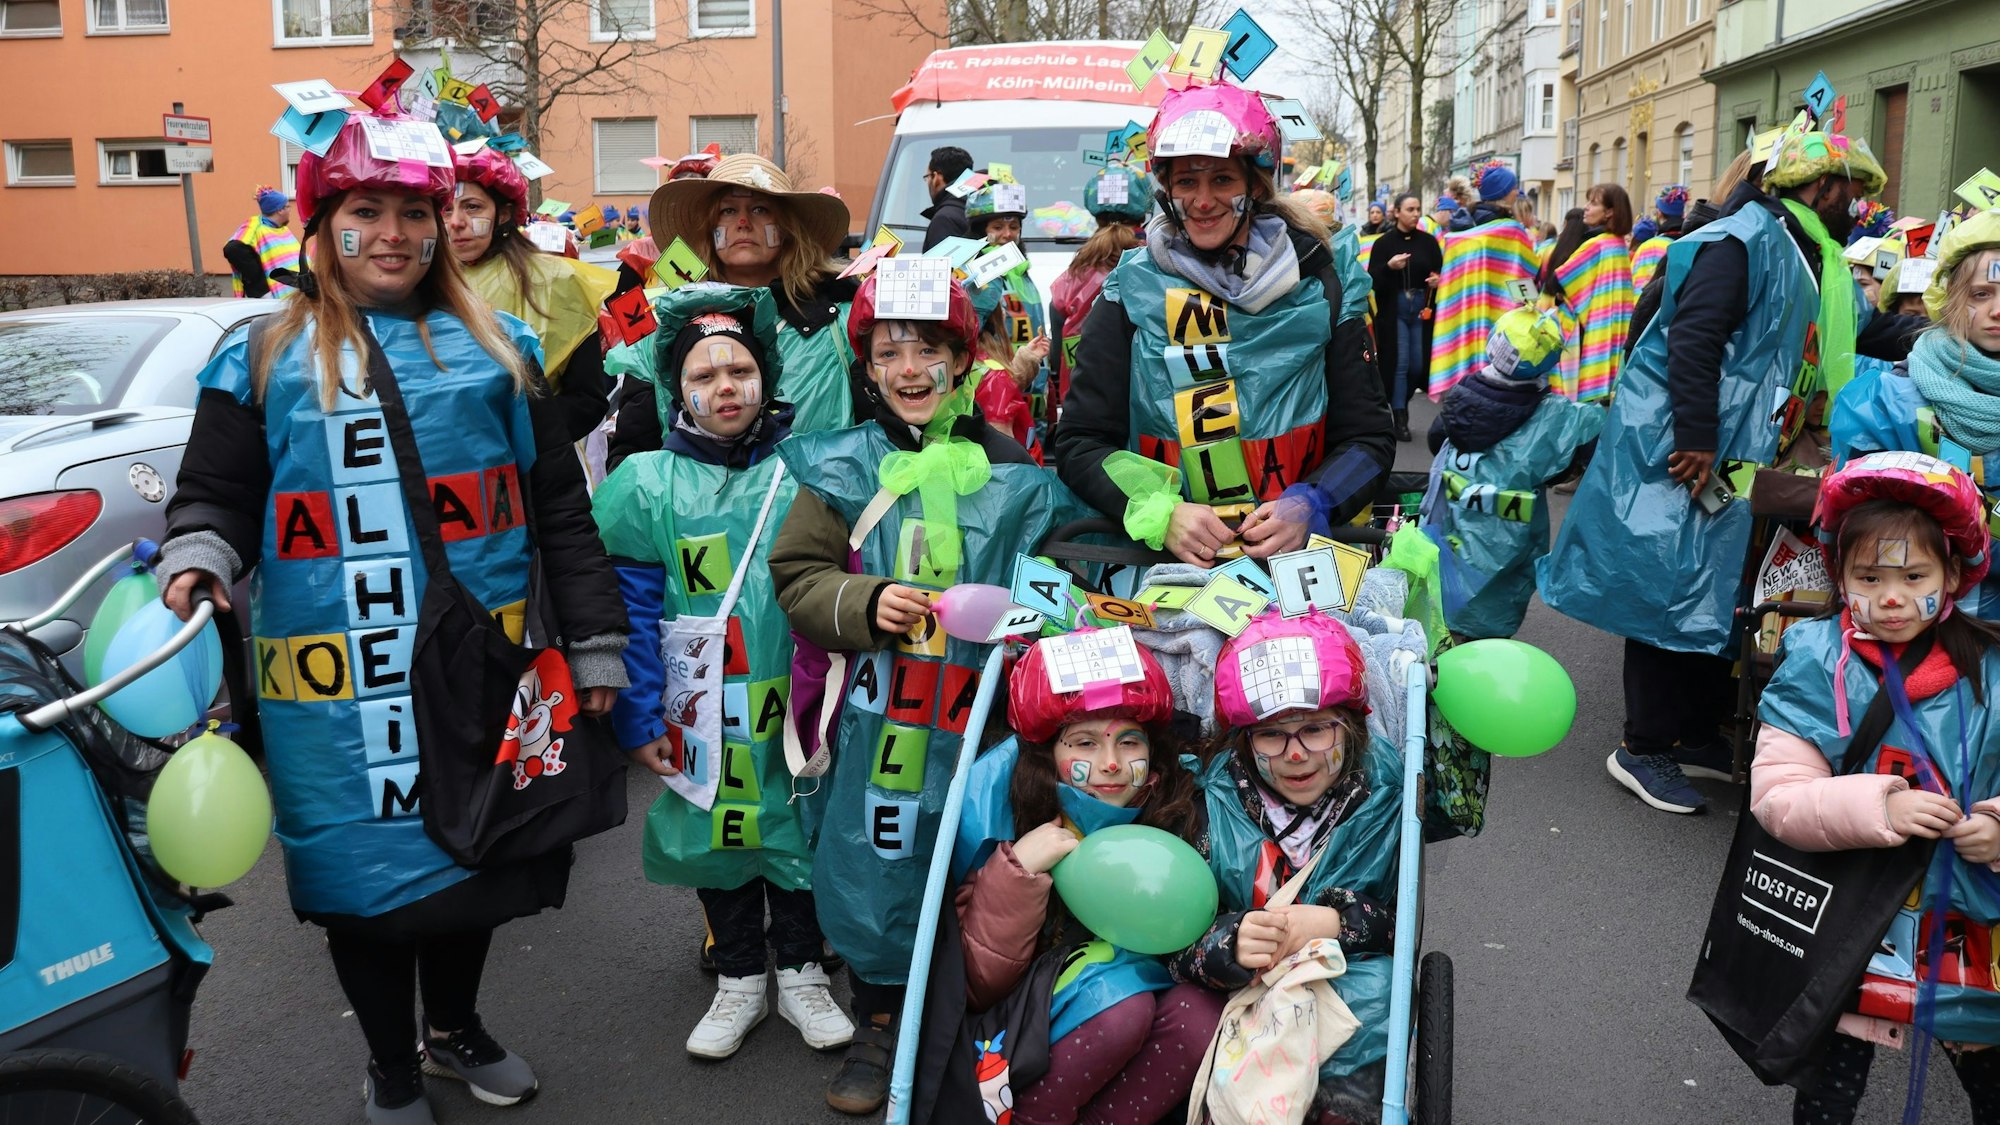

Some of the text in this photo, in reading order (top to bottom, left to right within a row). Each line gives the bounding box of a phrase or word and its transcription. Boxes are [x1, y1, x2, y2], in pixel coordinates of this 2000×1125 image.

[1189, 41, 1204, 67] L
[1228, 33, 1250, 62] L
[965, 55, 1078, 69] Realschule
[1084, 55, 1129, 69] Lass
[1143, 56, 1159, 71] L
[986, 75, 1133, 93] Köln-Mülheim
[167, 118, 208, 131] Feuerwehrzufahrt
[1281, 115, 1306, 126] F
[343, 233, 354, 252] E
[624, 302, 646, 327] K
[1762, 562, 1793, 589] NEW
[1797, 548, 1822, 567] YOR
[1029, 581, 1060, 606] A
[1297, 565, 1318, 601] F
[1214, 595, 1253, 622] A
[1926, 597, 1937, 615] B
[663, 652, 689, 679] see
[1072, 762, 1086, 782] S
[1135, 766, 1147, 780] M
[1745, 866, 1818, 913] SIDESTEP
[40, 942, 115, 986] THULE
